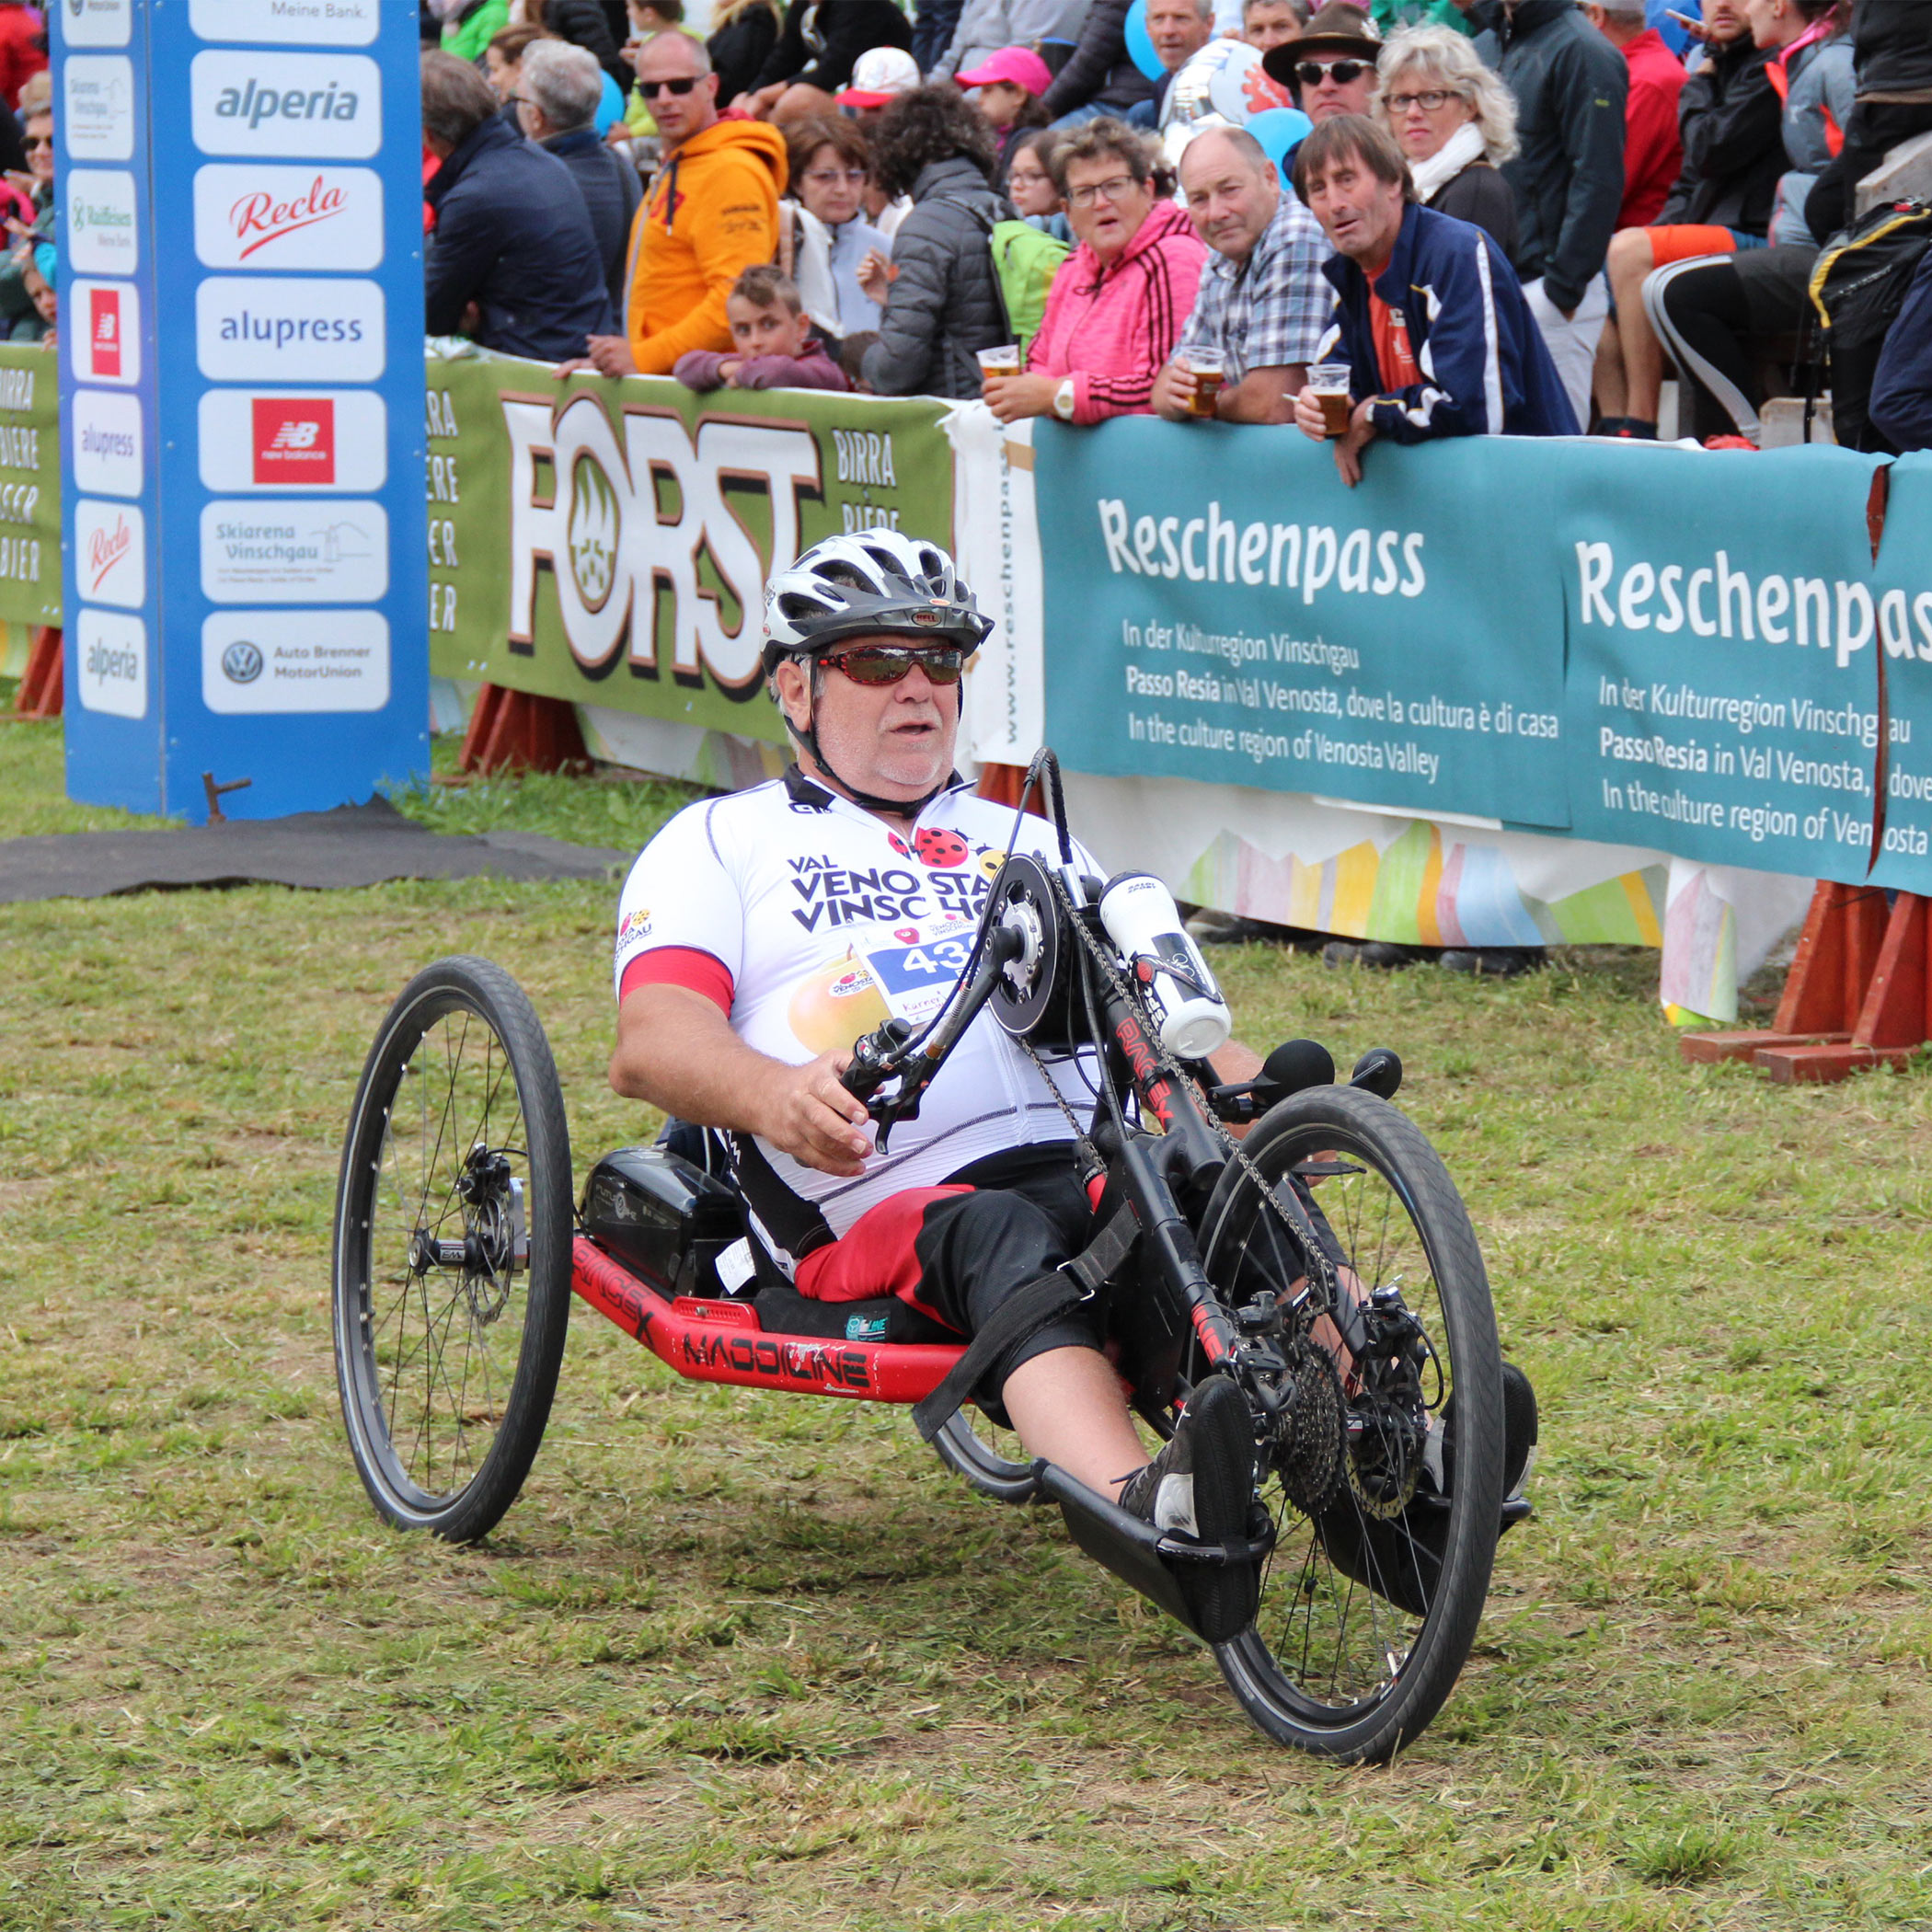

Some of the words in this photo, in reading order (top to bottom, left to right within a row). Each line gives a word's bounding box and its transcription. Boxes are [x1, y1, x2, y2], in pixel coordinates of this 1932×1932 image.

[271, 2, 319, 17] Meine
[325, 4, 367, 18] Bank.
[215, 79, 358, 130] alperia
[230, 175, 348, 238] Recla
[220, 311, 362, 348] alupress
[83, 422, 134, 462] alupress
[832, 429, 897, 487] BIRRA
[0, 482, 39, 524] EER
[216, 523, 295, 540] Skiarena
[225, 542, 318, 563] Vinschgau
[500, 390, 822, 696] FORST
[1098, 499, 1426, 605] Reschenpass
[1575, 541, 1932, 668] Reschenpas
[87, 638, 138, 684] alperia
[274, 646, 310, 659] Auto
[314, 646, 371, 659] Brenner
[275, 666, 362, 679] MotorUnion
[1122, 618, 1141, 646] In
[1144, 619, 1173, 650] der
[1176, 623, 1267, 667] Kulturregion
[1271, 633, 1360, 675] Vinschgau
[1126, 665, 1173, 696] Passo
[1176, 670, 1220, 702] Resia
[1222, 675, 1237, 703] in
[1236, 677, 1260, 707] Val
[1262, 681, 1343, 719] Venosta,
[1347, 686, 1385, 720] dove
[1387, 691, 1404, 723] la
[1409, 696, 1475, 730] cultura
[1479, 702, 1490, 731] è
[1495, 703, 1512, 734] di
[1518, 712, 1558, 739] casa
[1600, 675, 1617, 707] In
[1651, 683, 1786, 734] Kulturregion
[1791, 697, 1911, 749] Vinschgau
[1129, 712, 1144, 741] In
[1147, 712, 1176, 744] the
[1179, 718, 1235, 751] culture
[1238, 728, 1288, 764] region
[1293, 729, 1313, 760] of
[1315, 732, 1383, 769] Venosta
[1384, 742, 1439, 784] Valley
[1600, 726, 1655, 764] Passo
[1653, 734, 1708, 773] Resia
[1715, 742, 1734, 776] in
[1740, 746, 1772, 780] Val
[1777, 749, 1871, 799] Venosta,
[1890, 763, 1932, 802] dove
[1603, 778, 1623, 810] In
[1627, 780, 1659, 815] the
[1730, 801, 1797, 843] region
[1804, 806, 1830, 840] of
[1833, 811, 1929, 857] Venosta
[787, 855, 838, 874] VAL
